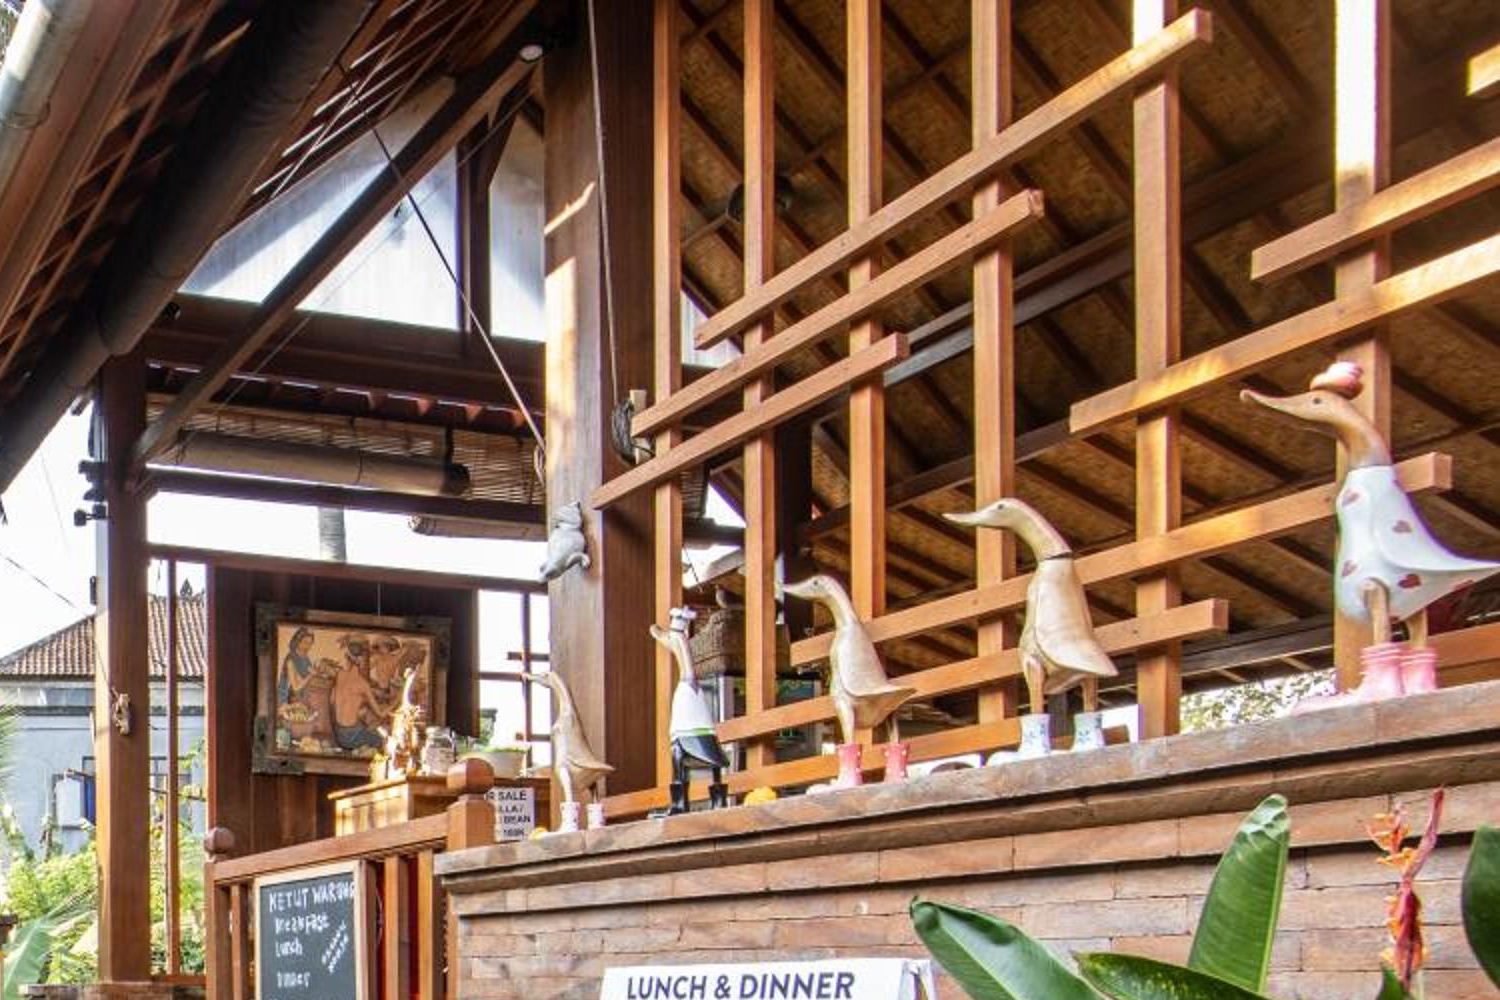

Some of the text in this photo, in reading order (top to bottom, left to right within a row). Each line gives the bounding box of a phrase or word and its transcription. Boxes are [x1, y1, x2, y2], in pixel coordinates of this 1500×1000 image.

[498, 791, 527, 800] SALE
[627, 971, 855, 1000] LUNCH & DINNER
